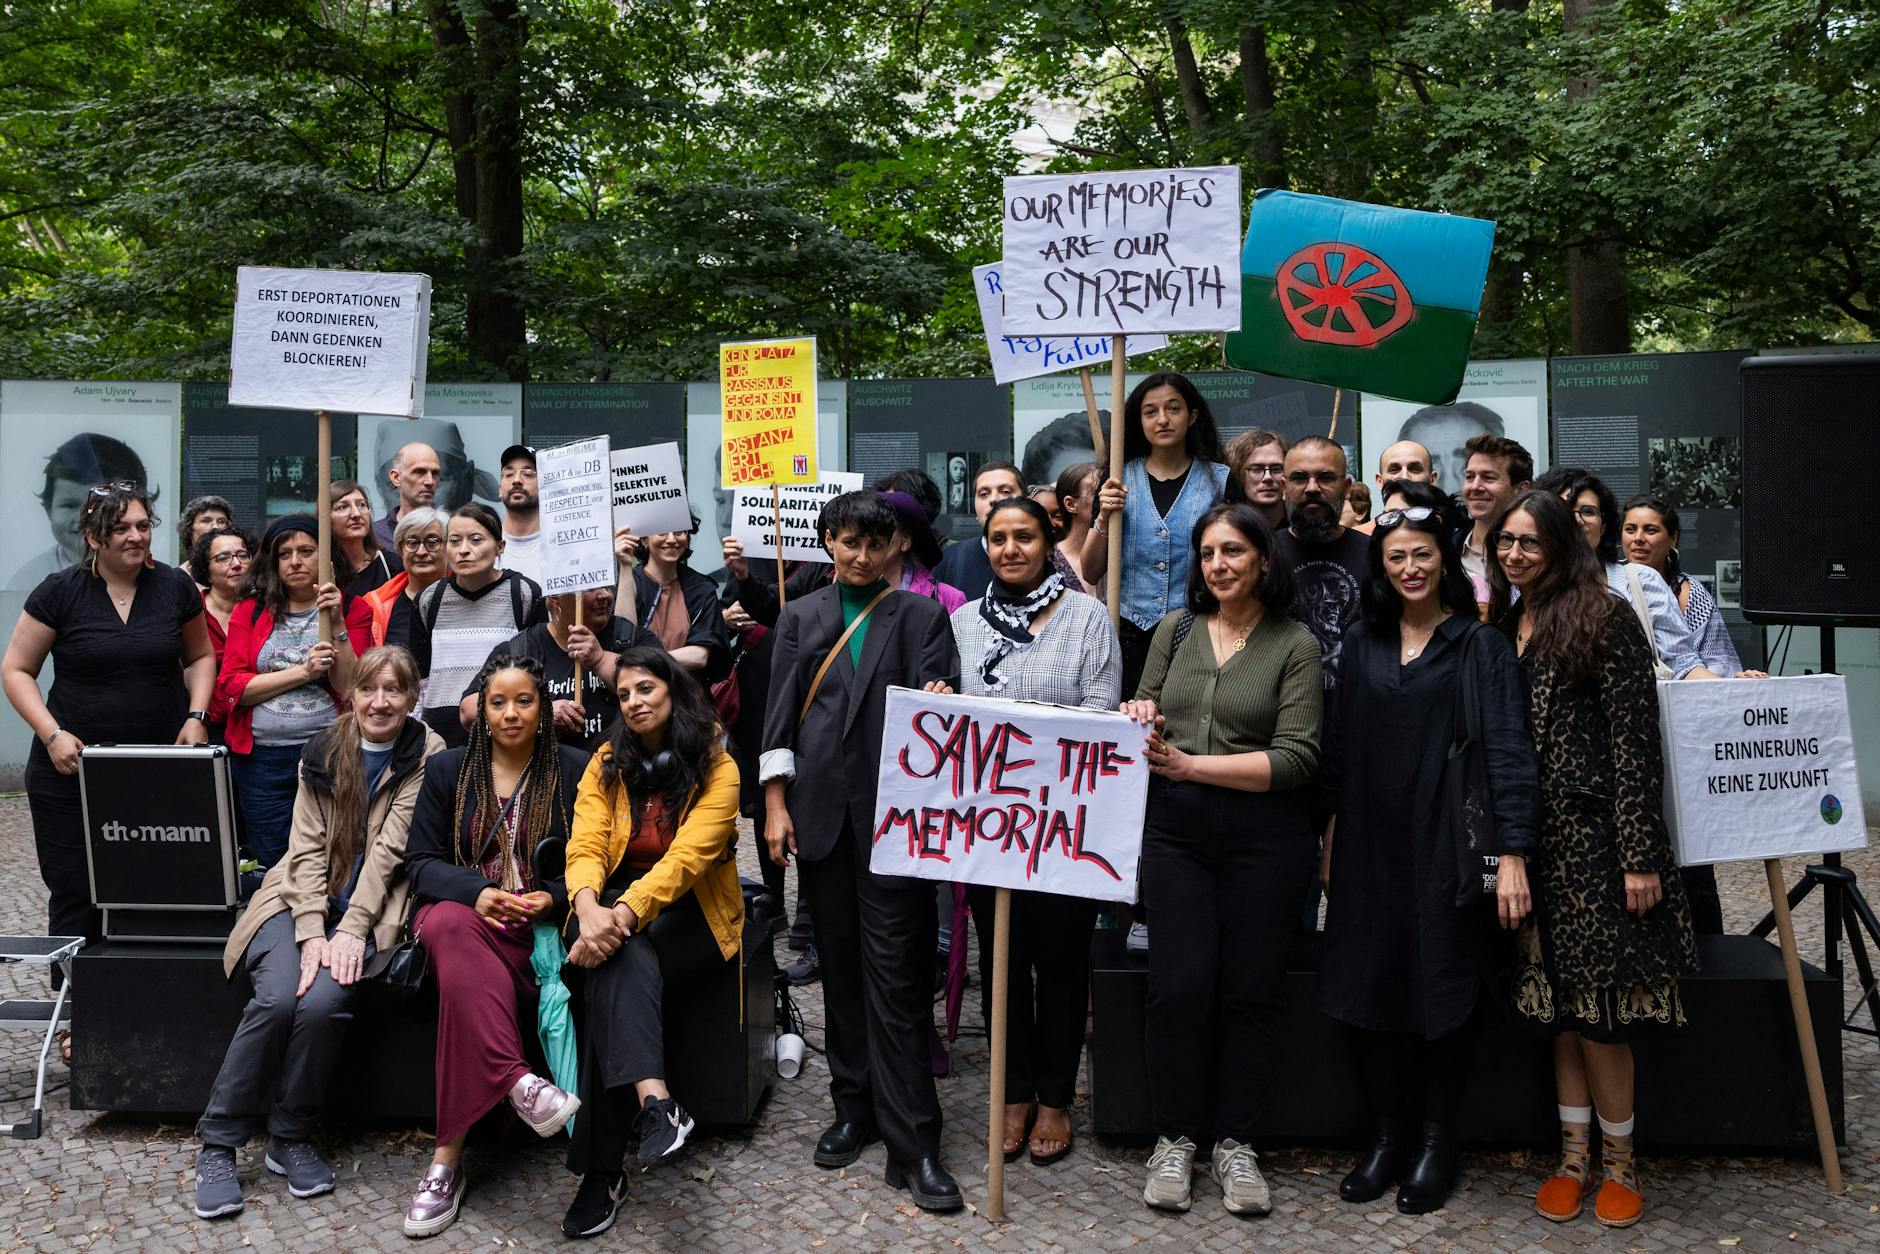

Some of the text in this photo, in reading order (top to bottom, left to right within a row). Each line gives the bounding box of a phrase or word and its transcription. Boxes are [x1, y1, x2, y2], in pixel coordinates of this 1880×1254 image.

[1010, 174, 1216, 230] OUR MEMORIES
[1039, 232, 1176, 267] ARE OUR
[258, 289, 401, 308] ERST DEPORTATIONEN
[1036, 265, 1226, 330] STRENGTH
[277, 310, 379, 330] KOORDINIEREN,
[271, 330, 382, 348] DANN GEDENKEN
[284, 351, 367, 368] BLOCKIEREN!
[725, 346, 797, 362] KEIN PLATZ
[1043, 336, 1133, 368] Futur
[1557, 360, 1660, 374] NACH DEM KRIEG
[725, 376, 792, 392] RASSISMUS
[854, 384, 913, 394] AUSCHWITZ
[1557, 374, 1649, 388] AFTER THE WAR
[73, 386, 137, 398] Adam Ujvary
[442, 388, 493, 398] Markowska
[726, 391, 803, 407] GEGEN SINTI
[191, 400, 209, 408] THE
[529, 399, 649, 409] WAR OF EXTERMINATION
[854, 396, 913, 406] AUSCHWITZ
[726, 407, 797, 422] UND ROMA
[724, 426, 794, 454] DISTANZ
[728, 451, 761, 470] IERT
[543, 469, 566, 482] SENAT
[584, 460, 601, 474] DB
[730, 463, 775, 485] EUCH!
[614, 475, 667, 492] SELEKTIVE
[828, 483, 843, 495] IN
[549, 495, 584, 511] RESPECT
[554, 510, 592, 524] EXISTENCE
[557, 526, 599, 542] EXPACT
[1832, 563, 1845, 572] JBL
[546, 569, 608, 590] RESISTANCE
[1743, 707, 1789, 727] OHNE
[898, 710, 1136, 800] SAVE THE
[1714, 737, 1819, 761] ERINNERUNG
[1707, 768, 1829, 795] KEINE ZUKUNFT
[101, 820, 211, 842] thomann
[874, 785, 1123, 882] MEMORIAL
